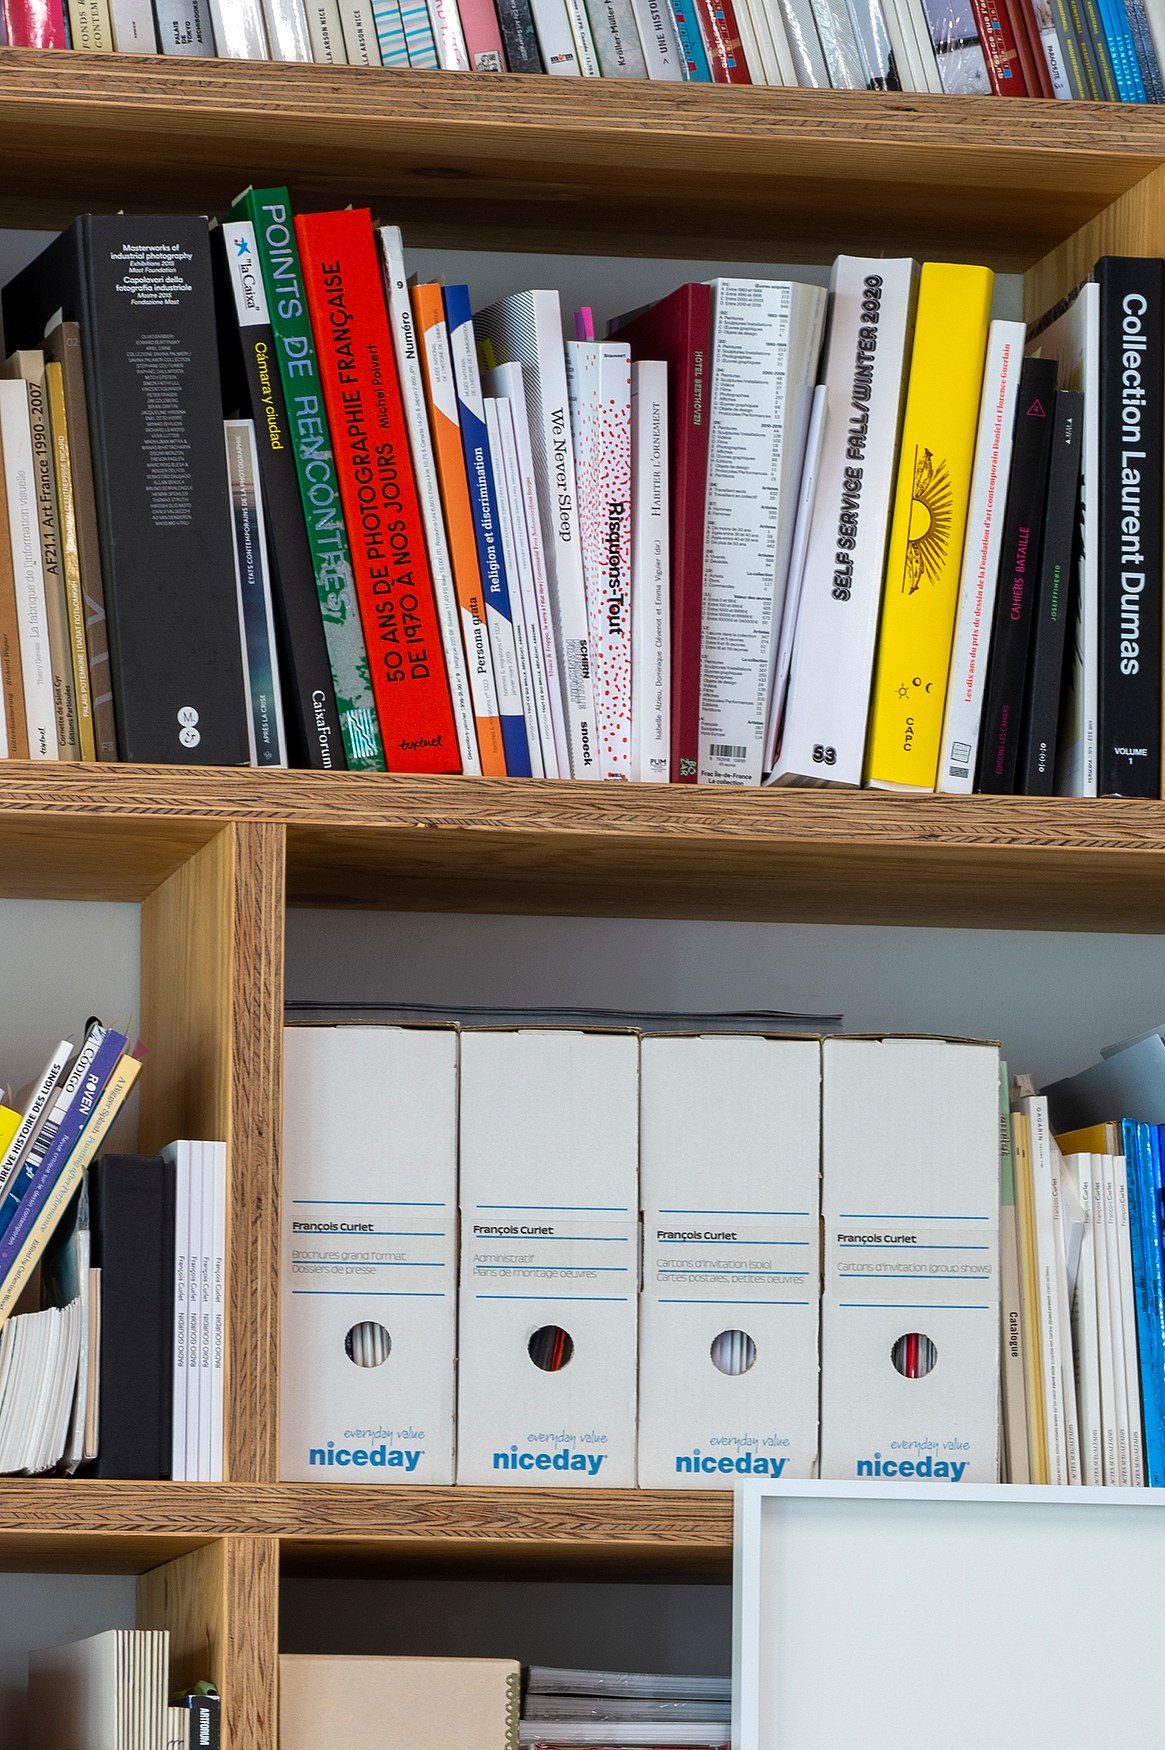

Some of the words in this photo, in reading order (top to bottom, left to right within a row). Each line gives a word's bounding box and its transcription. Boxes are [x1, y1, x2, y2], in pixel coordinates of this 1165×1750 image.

[173, 20, 181, 45] PALAIS
[181, 33, 188, 45] DE
[608, 7, 626, 67] Kröller-Müller
[123, 244, 170, 252] Masterworks
[171, 244, 181, 252] of
[146, 253, 193, 261] photography
[116, 284, 152, 292] fotografia
[154, 284, 192, 292] industriale
[123, 276, 164, 285] Capolavori
[164, 276, 184, 284] della
[262, 204, 301, 318] POINTS
[284, 336, 313, 377] DE
[860, 274, 884, 323] 2020
[328, 261, 356, 382] FRANÇAISE
[402, 311, 416, 360] Numéro
[254, 341, 273, 391] Cámara
[367, 345, 384, 386] Poivert
[1120, 292, 1147, 444] Collection
[30, 382, 42, 410] 2007
[264, 393, 272, 406] y
[375, 389, 391, 428] Michel
[846, 324, 879, 461] FALL/WINTER
[33, 417, 47, 451] 1990
[264, 406, 284, 449] ciudad
[552, 408, 564, 435] We
[650, 402, 661, 466] L'ORNEMENT
[37, 458, 54, 502] France
[345, 392, 383, 560] PHOTOGRAPHIE
[377, 442, 406, 507] JOURS
[555, 438, 570, 486] Never
[651, 468, 662, 517] HABITER
[840, 466, 862, 551] SERVICE
[1120, 453, 1146, 564] Laurent
[44, 503, 59, 528] Art
[556, 490, 574, 543] Sleep
[46, 527, 59, 576] AF21.1
[391, 520, 413, 563] NOS
[1017, 526, 1030, 573] BATAILLE
[372, 566, 390, 597] DE
[397, 568, 417, 591] À
[607, 502, 625, 635] Risquons-Tout
[831, 554, 853, 601] SELF
[402, 594, 424, 644] 1970
[469, 597, 481, 623] grata
[1010, 576, 1026, 621] CAHIERS
[378, 602, 401, 646] ANS
[1119, 572, 1145, 676] Dumas
[387, 651, 405, 682] 50
[411, 649, 430, 680] DE
[475, 624, 489, 674] Persona
[311, 690, 333, 769] CaixaForum
[400, 734, 445, 750] textuel
[581, 722, 593, 766] snoeck
[1114, 746, 1148, 757] VOLUME
[812, 744, 837, 764] 53
[1127, 757, 1134, 765] 1
[12, 1113, 38, 1151] HISTOIRE
[33, 1094, 46, 1116] DES
[41, 1063, 62, 1096] LIGNES
[292, 1222, 338, 1232] François
[340, 1222, 374, 1231] Curlet
[1008, 1311, 1019, 1357] Catalogue
[310, 1441, 422, 1471] niceday
[493, 1445, 607, 1476] niceday
